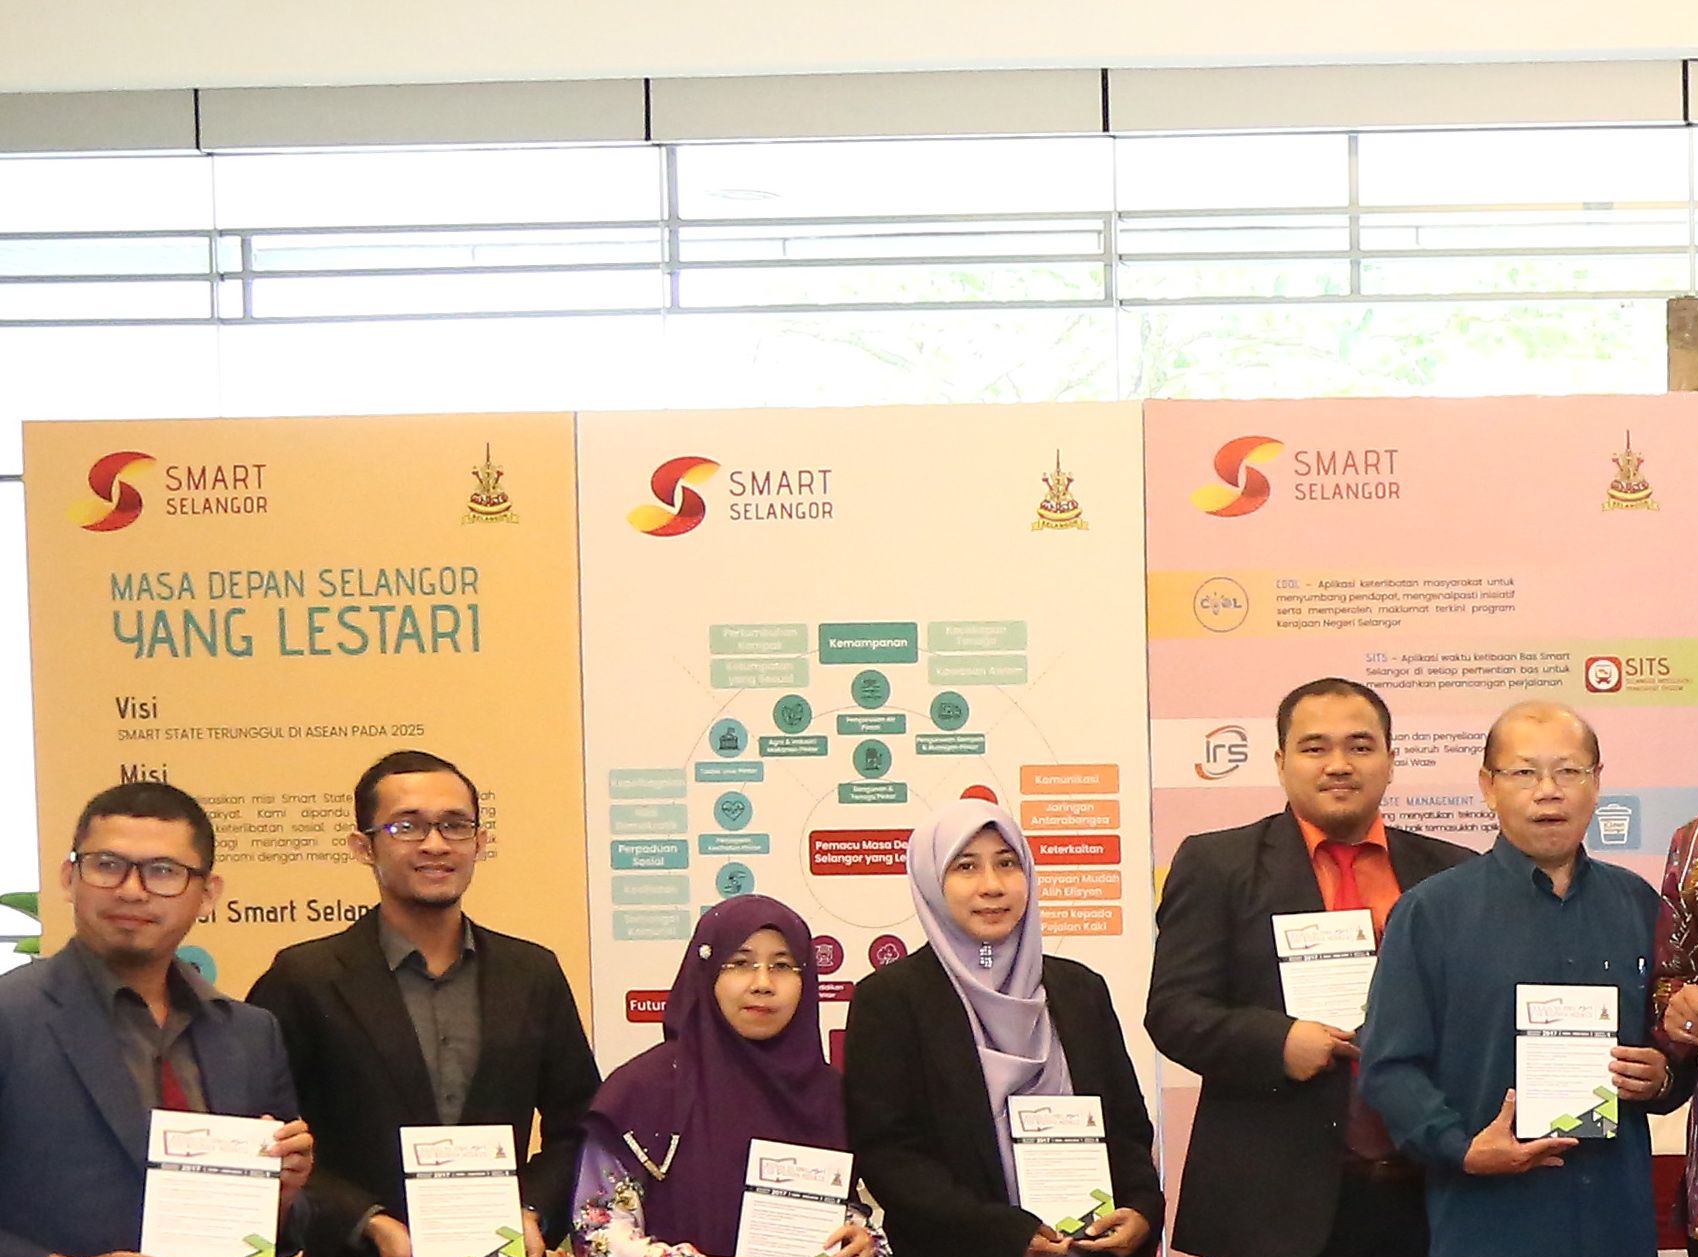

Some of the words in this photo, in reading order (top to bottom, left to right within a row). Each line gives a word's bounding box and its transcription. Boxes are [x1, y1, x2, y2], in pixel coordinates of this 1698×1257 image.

[1294, 449, 1398, 476] SMART
[166, 464, 267, 491] SMART
[729, 469, 833, 497] SMART
[1294, 482, 1400, 500] SELANGOR
[166, 496, 268, 515] SELANGOR
[730, 502, 833, 520] SELANGOR
[111, 571, 195, 600] MASA
[208, 569, 305, 599] DEPAN
[319, 566, 479, 597] SELANGOR
[1487, 578, 1514, 586] untuk
[1471, 605, 1515, 614] program
[113, 608, 253, 659] YANG
[279, 604, 481, 656] LESTARI
[829, 638, 908, 649] Kemampanan
[1625, 657, 1670, 676] SITS
[116, 696, 157, 719] Visi
[118, 729, 161, 740] SMART
[165, 728, 204, 740] STATE
[207, 727, 285, 739] TERUNGGUL
[289, 727, 302, 738] DI
[306, 726, 348, 738] ASEAN
[352, 725, 387, 737] PADA
[391, 724, 424, 736] 2025
[120, 764, 168, 784] Misi
[1035, 775, 1099, 785] Komunikasi
[282, 794, 316, 803] Smart
[323, 793, 353, 803] State
[1046, 803, 1094, 814] Jaringan
[1031, 816, 1110, 826] Antarabangsa
[618, 845, 678, 857] Perpaduan
[815, 840, 860, 850] Pemacu
[862, 840, 892, 850] Masa
[1040, 845, 1103, 855] Keterkaitan
[815, 853, 862, 865] Selangor
[865, 855, 893, 866] yang
[1082, 875, 1119, 884] Mudah
[227, 900, 296, 923] Smart
